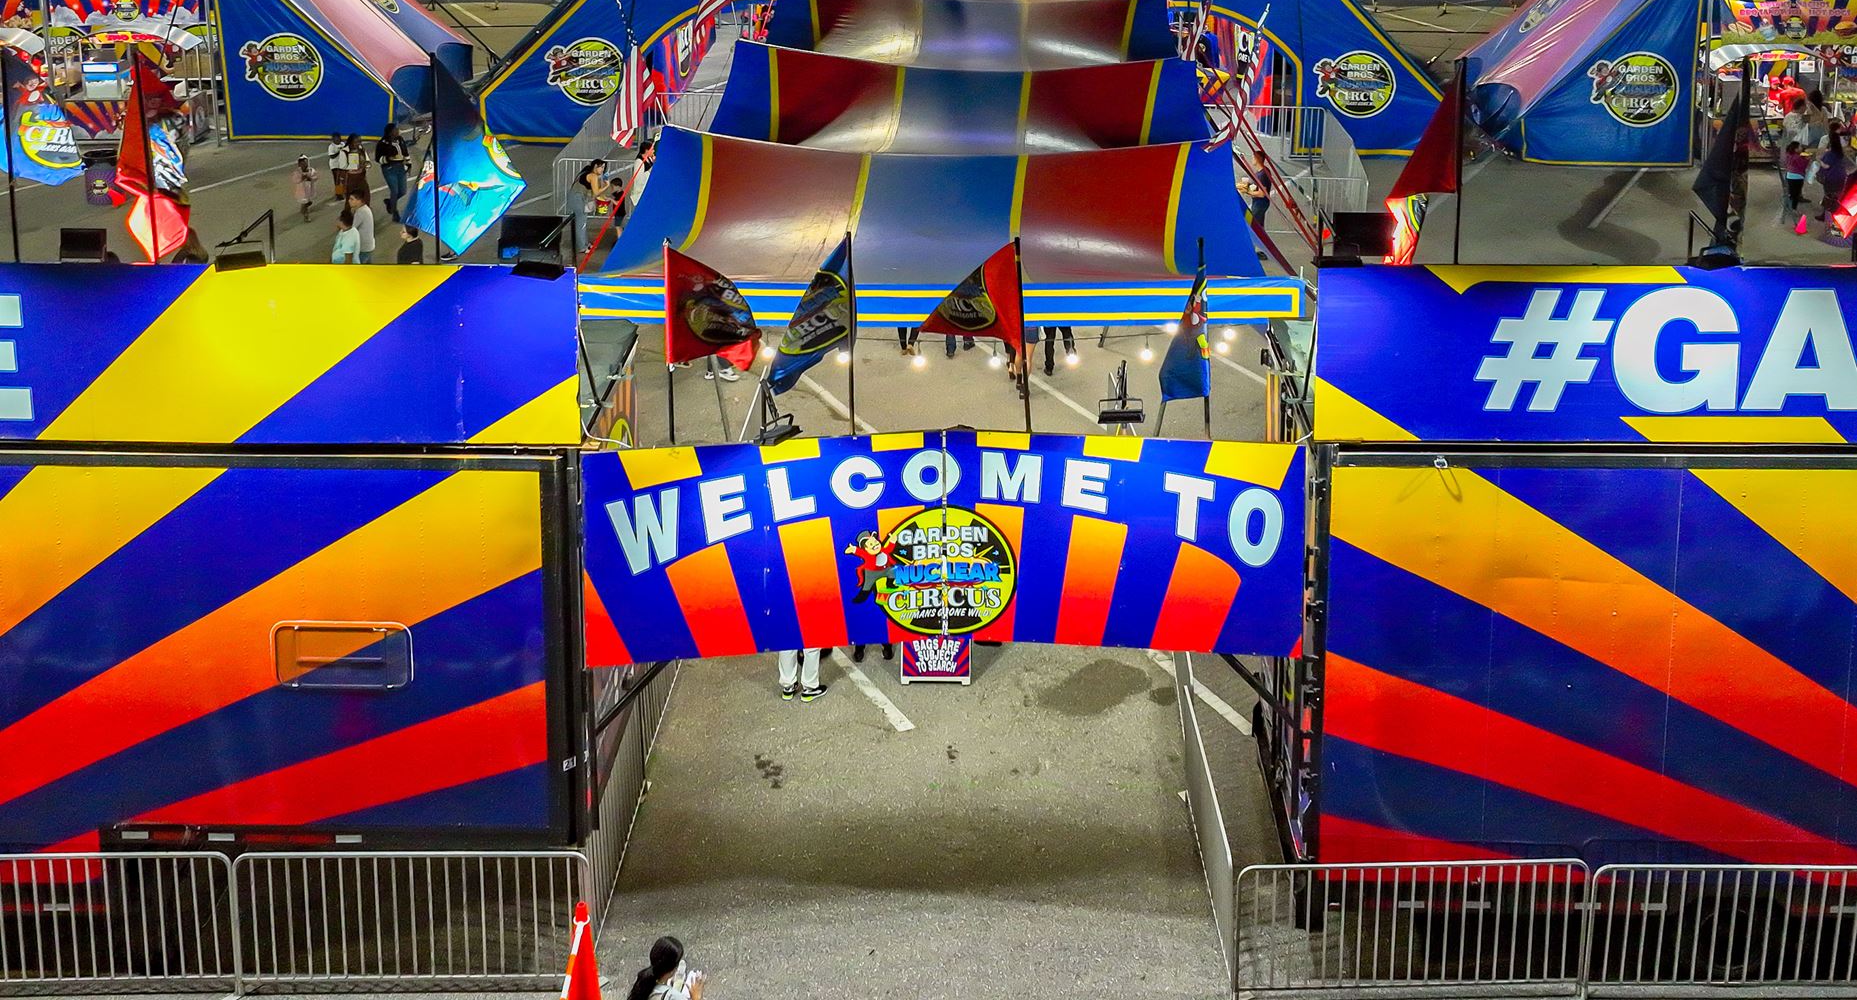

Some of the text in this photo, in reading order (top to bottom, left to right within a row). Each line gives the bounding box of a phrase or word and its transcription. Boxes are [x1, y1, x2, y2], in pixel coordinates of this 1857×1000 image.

[1340, 63, 1380, 72] GARDEN
[1474, 286, 1857, 413] #GA
[605, 449, 1285, 576] WELCOME TO
[897, 525, 989, 547] GARDEN
[912, 542, 974, 562] BROS
[893, 561, 1001, 586] NUCLEAR
[888, 586, 1001, 612] CIRCUS
[912, 638, 961, 654] BAGS ARE
[917, 649, 957, 663] SUBJECT
[915, 660, 957, 674] TO SEARCH
